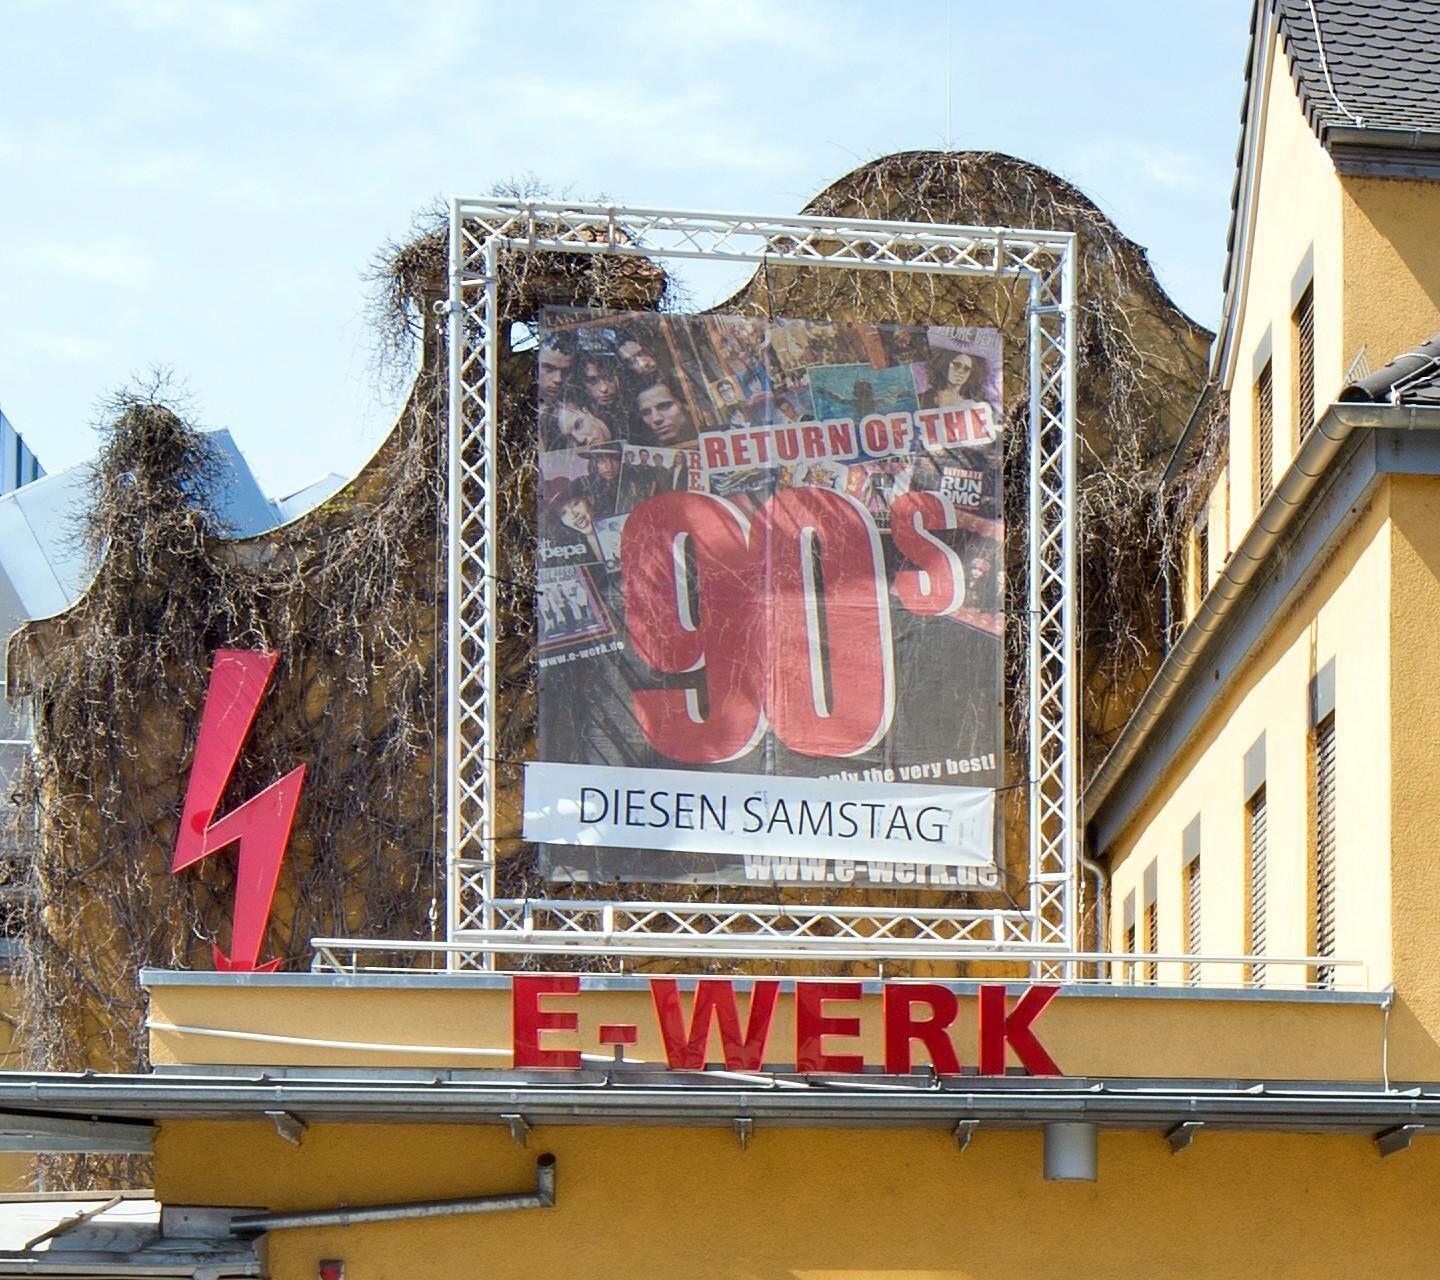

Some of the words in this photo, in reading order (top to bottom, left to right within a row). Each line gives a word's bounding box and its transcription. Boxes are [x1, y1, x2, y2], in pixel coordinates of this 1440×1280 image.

[703, 423, 853, 468] RETURN
[864, 419, 909, 453] OF
[918, 408, 992, 451] THE
[941, 476, 982, 494] RUN
[539, 641, 625, 668] www.e-werk.de
[863, 767, 895, 783] the
[899, 761, 941, 780] very
[946, 753, 996, 775] best!
[580, 787, 727, 831] DIESEN
[743, 796, 944, 842] SAMSTAG
[512, 974, 1063, 1077] E-WERK
